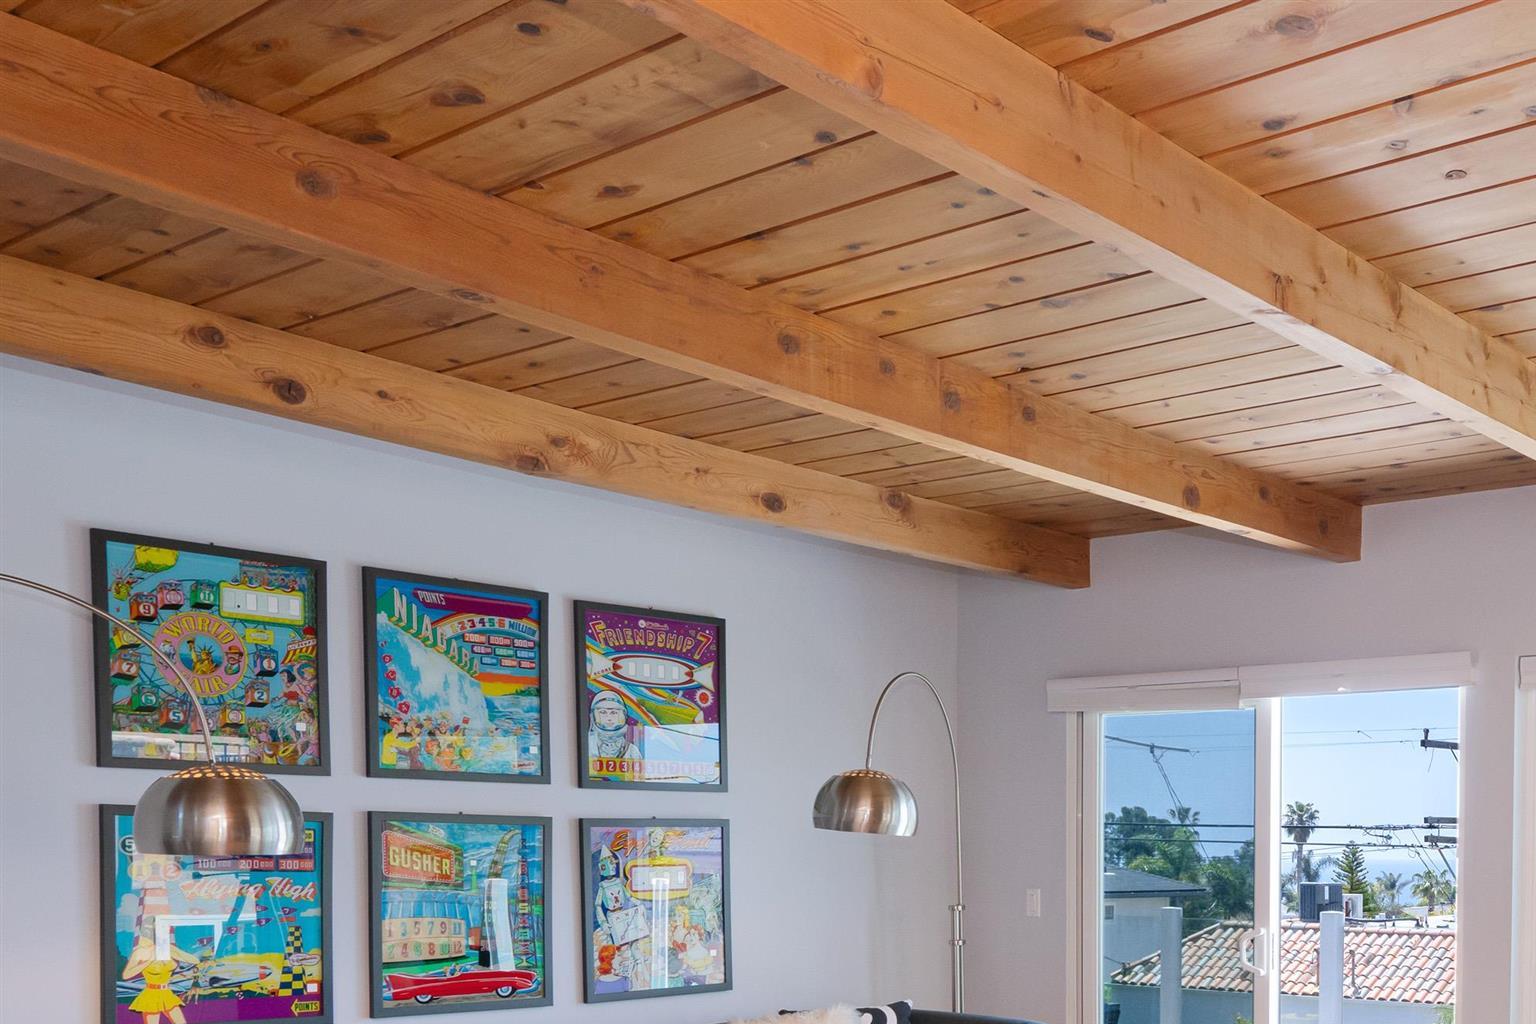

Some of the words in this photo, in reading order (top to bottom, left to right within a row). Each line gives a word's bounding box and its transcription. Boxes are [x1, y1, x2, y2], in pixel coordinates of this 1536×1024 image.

[417, 590, 446, 605] POINTS
[162, 615, 236, 644] WORLD
[589, 620, 696, 653] FRIENDSHIP
[693, 632, 713, 659] 7
[257, 691, 264, 701] 2
[389, 846, 451, 876] GUSHER
[181, 880, 266, 900] Flying
[266, 877, 317, 902] High
[440, 921, 447, 935] 9
[428, 942, 436, 956] 8
[294, 1001, 319, 1012] POINTS
